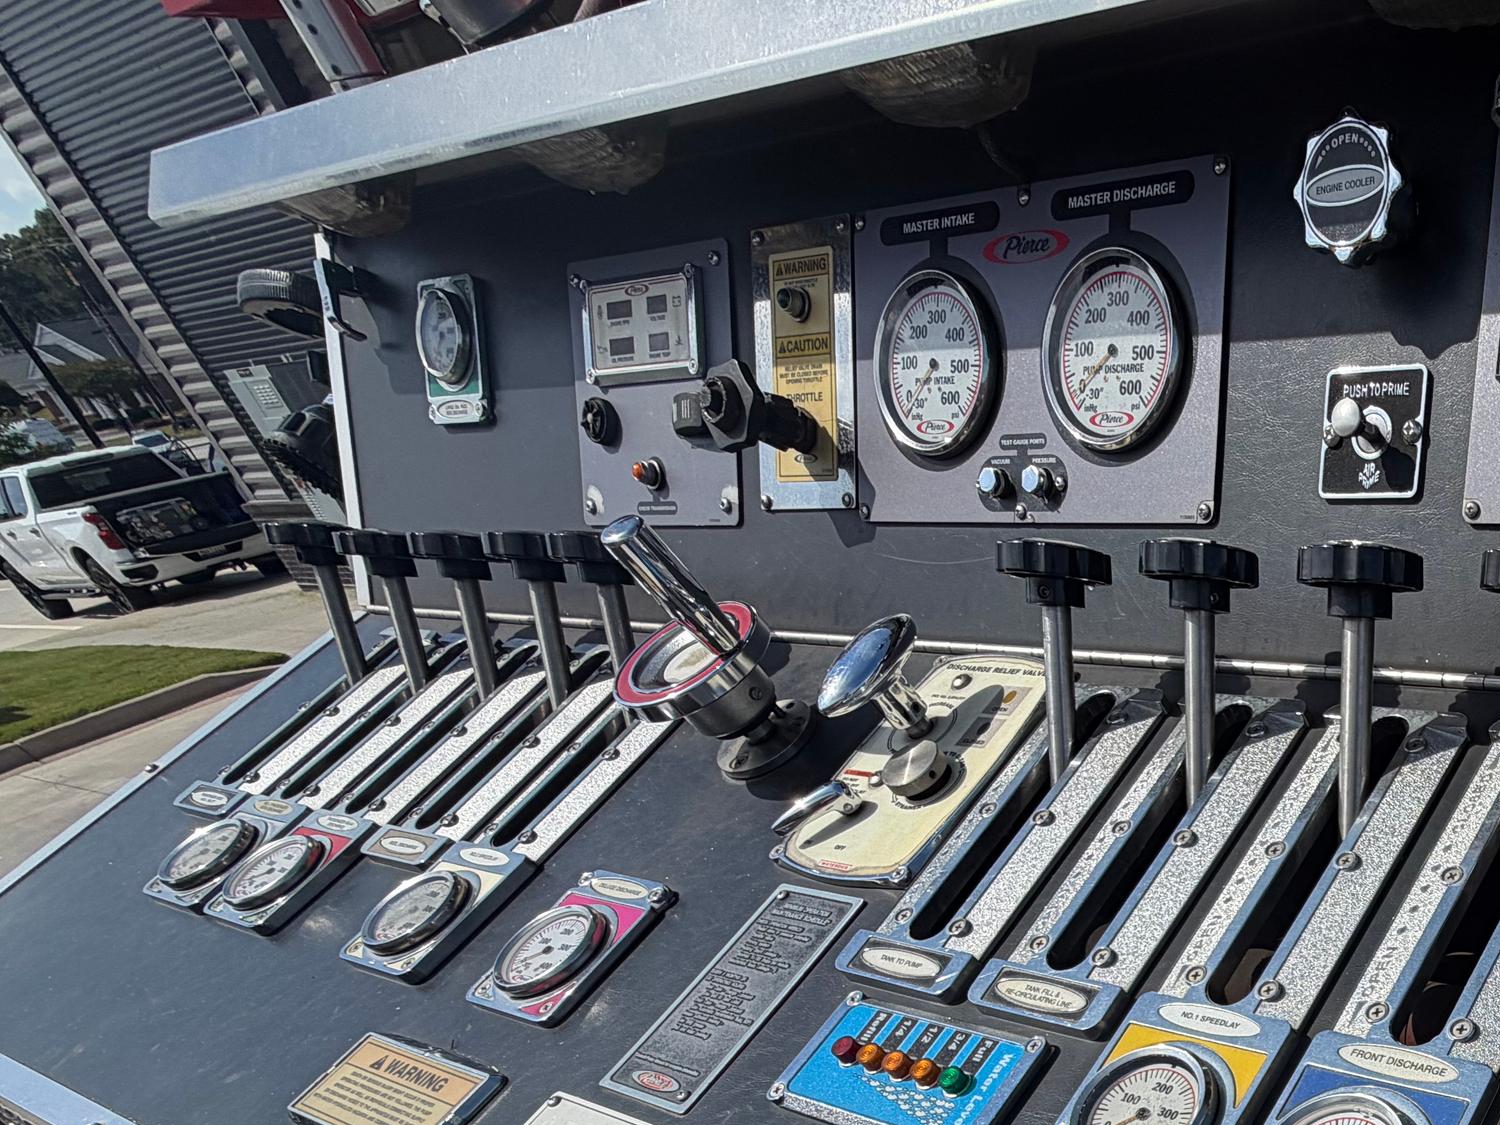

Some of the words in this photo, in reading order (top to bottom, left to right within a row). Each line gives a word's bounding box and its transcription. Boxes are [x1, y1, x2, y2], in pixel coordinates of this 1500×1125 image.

[1331, 133, 1358, 148] OPEN
[1316, 182, 1343, 195] ENGINE
[1344, 177, 1375, 190] COOLER
[1068, 192, 1110, 209] MASTER
[1113, 181, 1176, 202] DISCHARGE
[903, 217, 940, 234] MASTER
[941, 212, 975, 228] INTAKE
[1003, 236, 1050, 259] Pierce
[784, 257, 826, 275] WARNING
[1107, 290, 1129, 307] 300
[927, 309, 946, 324] 300
[1085, 307, 1106, 324] 200
[1127, 310, 1150, 326] 400
[910, 324, 928, 339] 200
[945, 327, 964, 342] 400
[787, 338, 828, 353] CAUTION
[1074, 341, 1094, 357] 100
[1132, 345, 1154, 360] 500
[901, 355, 918, 370] 100
[950, 358, 969, 373] 500
[1120, 379, 1142, 395] 600
[1344, 384, 1368, 397] PUSH
[1369, 382, 1380, 396] TO
[1381, 382, 1410, 396] PRIME
[787, 392, 823, 402] THROTTLE
[941, 390, 960, 405] 600
[1364, 463, 1375, 474] AIR
[1359, 471, 1380, 489] PRIME
[947, 664, 992, 673] DISCHARGE
[992, 667, 1021, 675] RELIEF
[881, 953, 896, 963] TANK
[897, 957, 904, 965] TO
[905, 959, 923, 969] PUMP
[1005, 987, 1055, 1006] RE-CIRCULATING
[1056, 1000, 1073, 1009] LINE
[1024, 984, 1041, 995] TANK
[1041, 988, 1054, 998] FILL
[859, 1013, 886, 1042] Refill
[898, 1020, 912, 1038] 1/4
[1200, 1014, 1241, 1030] SPEEDLAY
[921, 1027, 937, 1043] 1/2
[948, 1034, 966, 1051] 3/4
[973, 1039, 993, 1062] Full
[1350, 1049, 1386, 1066] FRONT
[1388, 1057, 1448, 1077] DISCHARGE
[384, 1058, 448, 1093] WARNING
[980, 1053, 1011, 1091] Water
